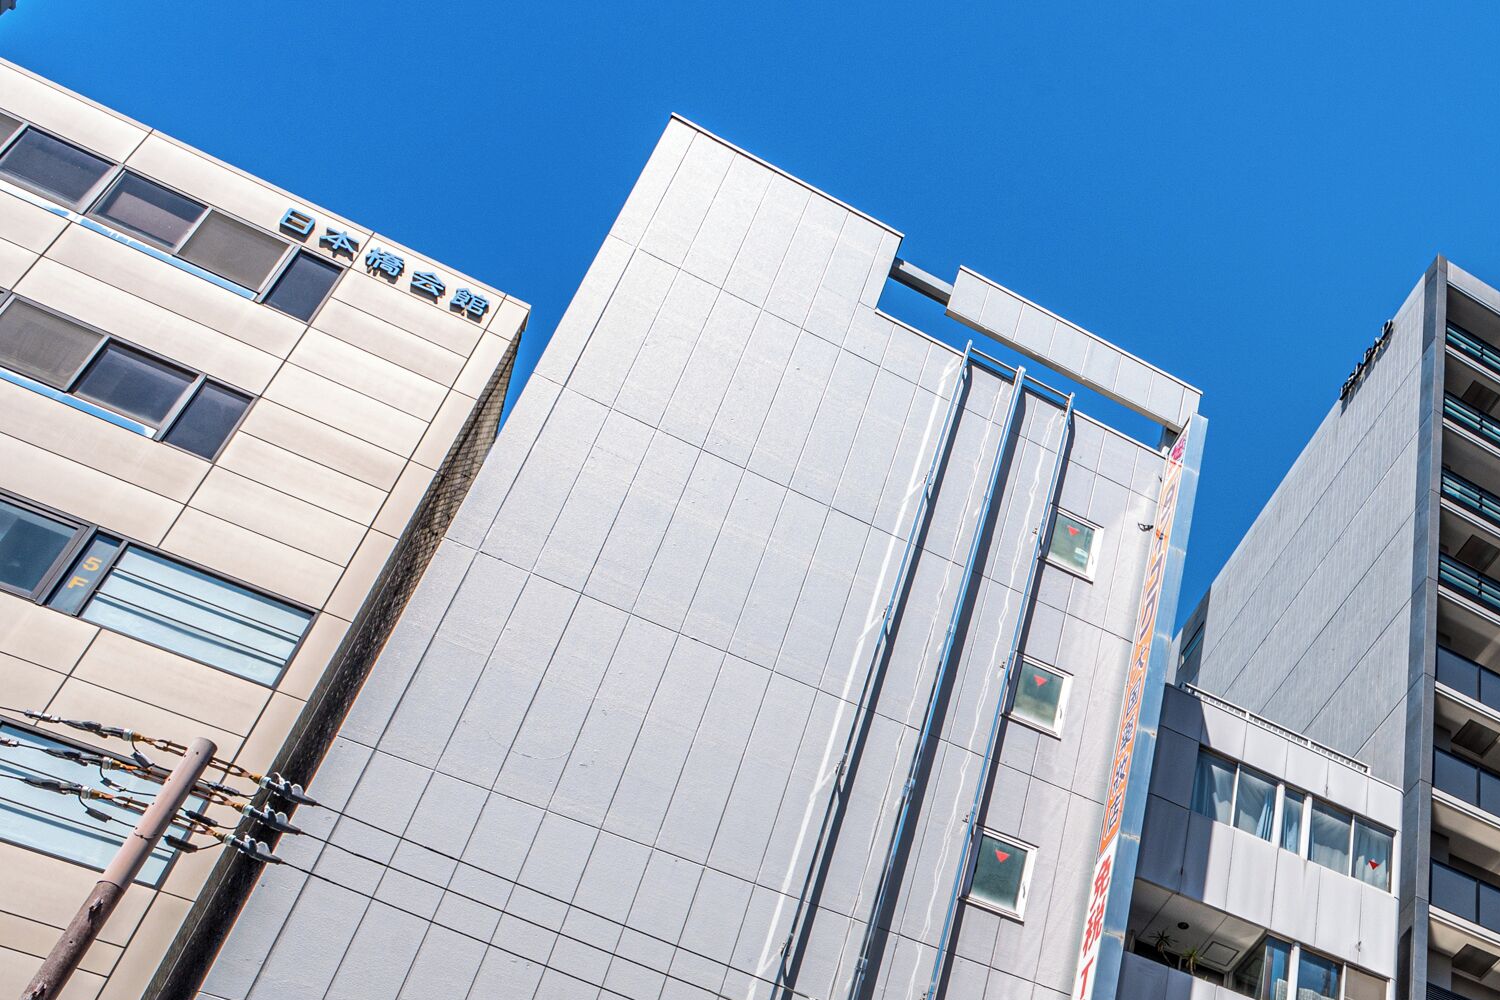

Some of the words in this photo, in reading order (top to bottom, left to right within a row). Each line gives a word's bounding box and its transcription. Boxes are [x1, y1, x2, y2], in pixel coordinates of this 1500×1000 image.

[279, 207, 490, 320] 日本橋会館
[1082, 855, 1112, 959] 免税
